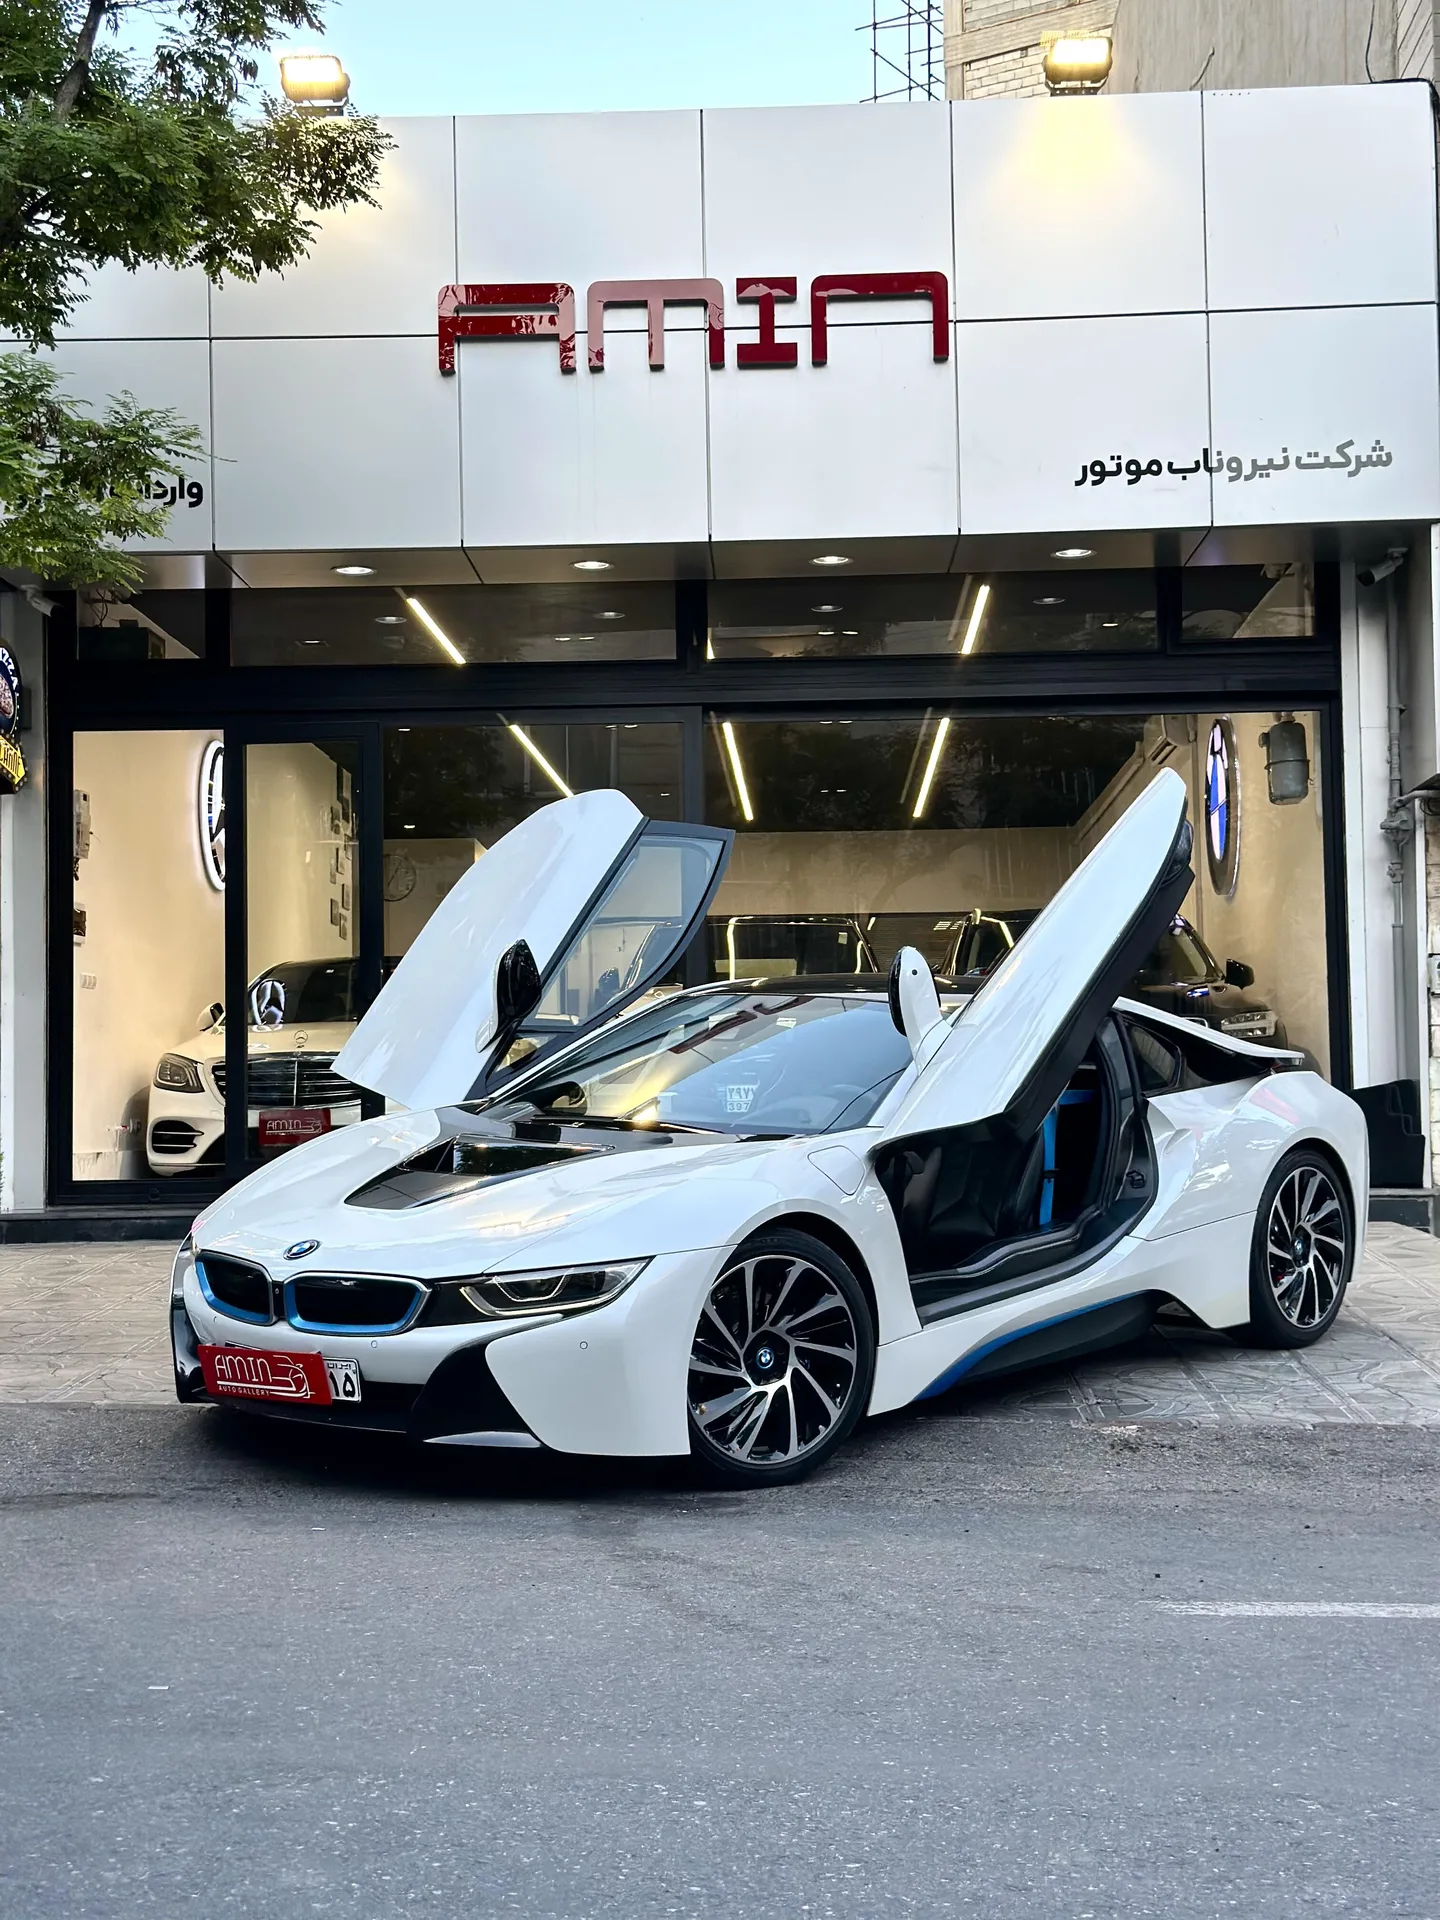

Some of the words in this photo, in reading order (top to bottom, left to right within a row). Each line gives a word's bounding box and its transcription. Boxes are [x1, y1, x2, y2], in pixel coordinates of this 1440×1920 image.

[437, 271, 949, 376] AMIN
[1074, 454, 1163, 487] موتور
[1296, 439, 1393, 478] شرکت
[266, 1119, 302, 1130] AMIN
[214, 1354, 273, 1383] AMIN
[329, 1370, 356, 1398] ۱۵
